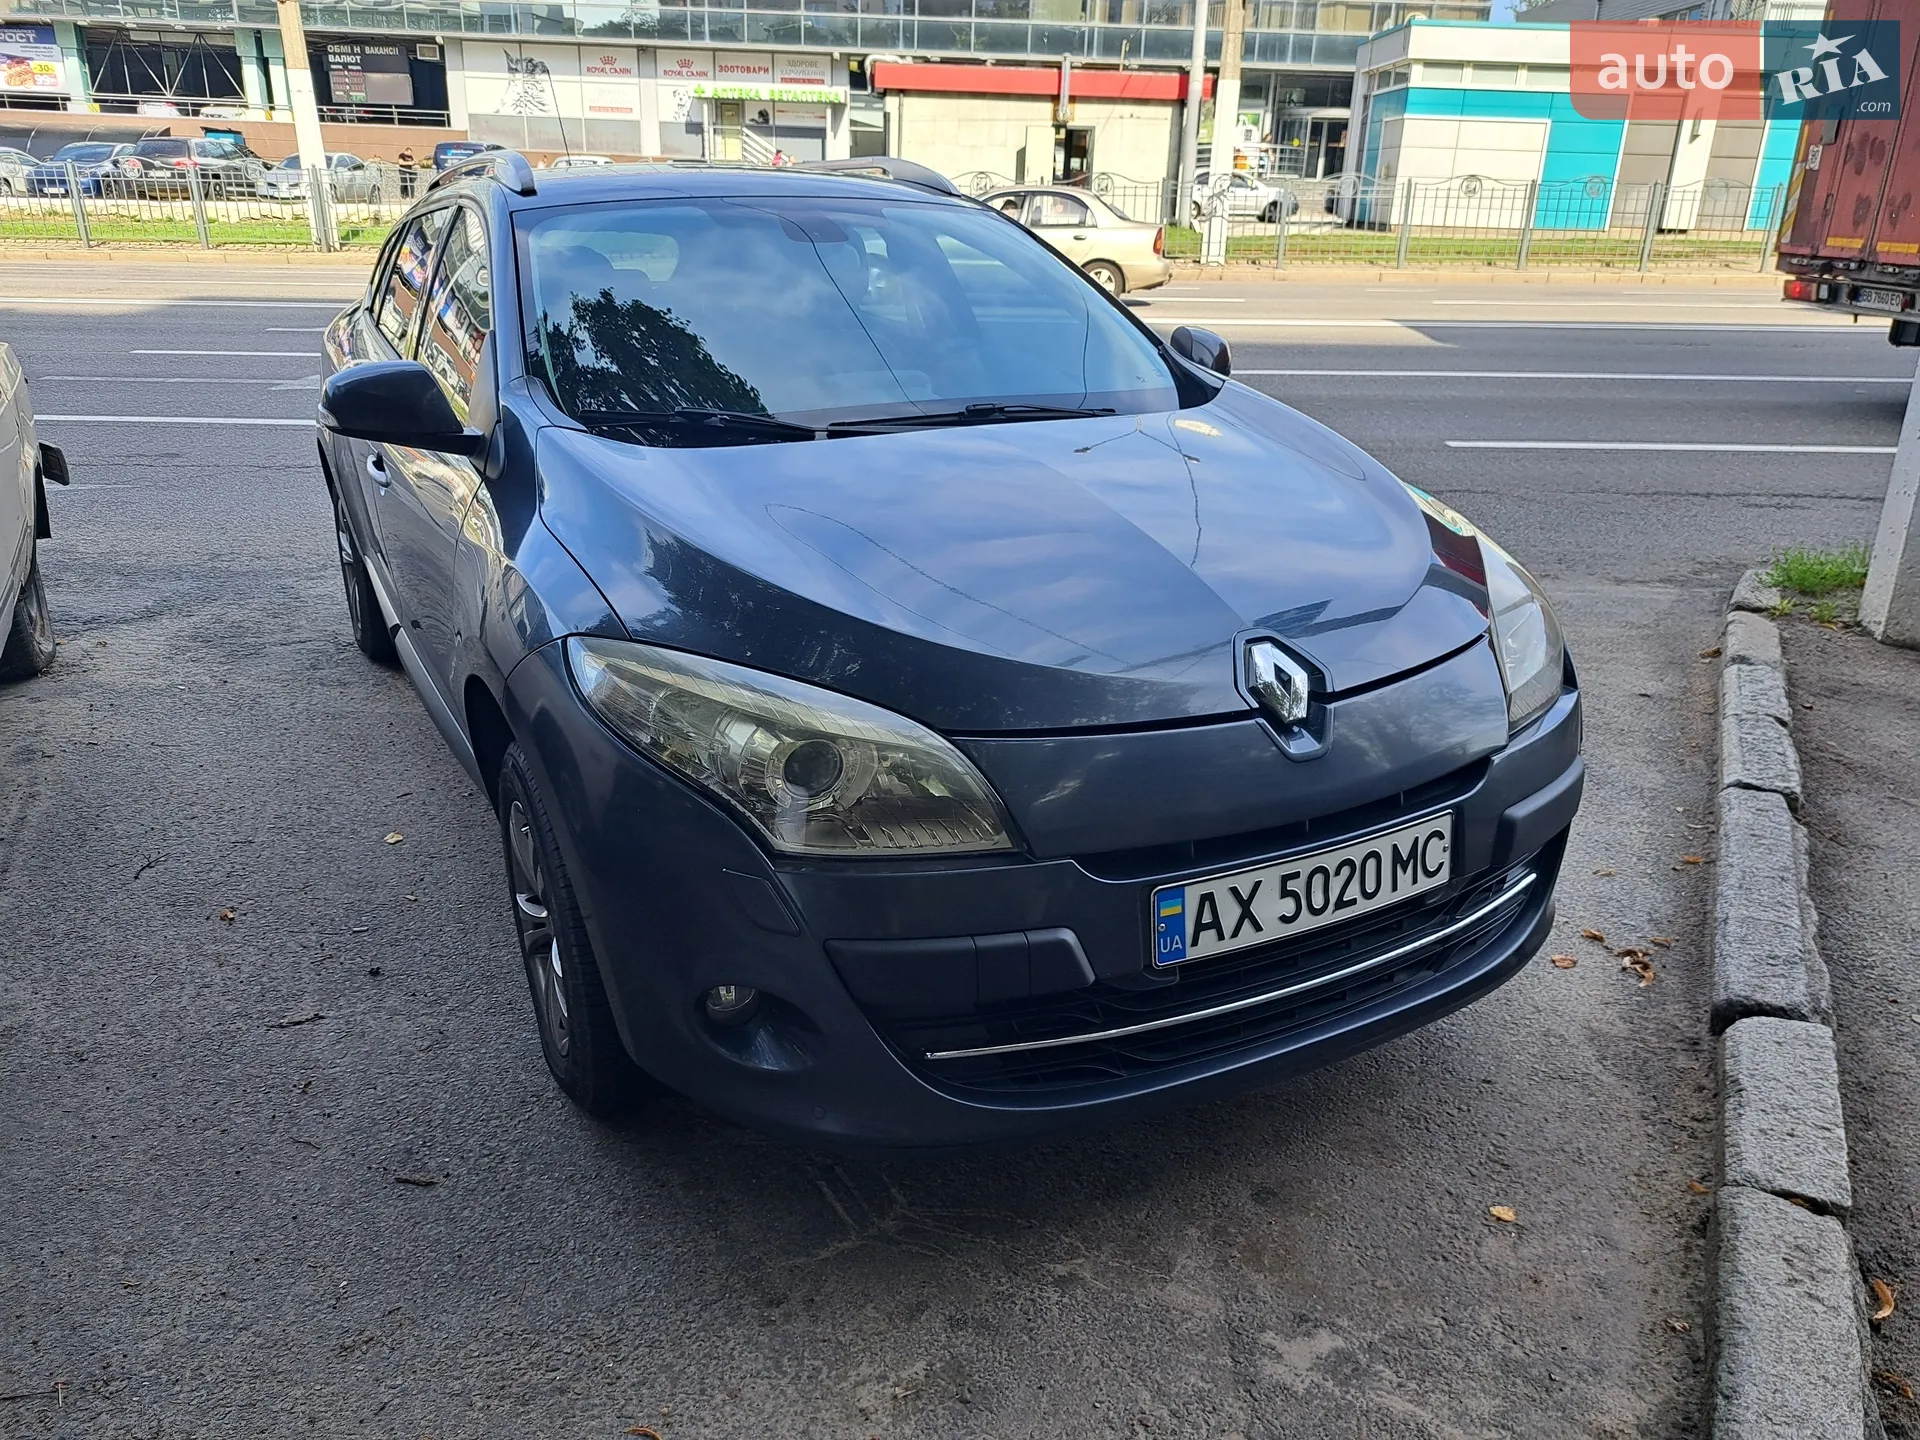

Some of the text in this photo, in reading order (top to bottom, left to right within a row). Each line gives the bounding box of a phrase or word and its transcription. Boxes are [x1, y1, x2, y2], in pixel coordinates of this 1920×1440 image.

[328, 55, 361, 63] ВАЛЮТ
[786, 60, 819, 68] ЗДОРОВЕ
[586, 66, 632, 75] ROYAL CANIN
[663, 69, 709, 78] ROYAL CANIN
[717, 64, 770, 75] ЗООТОВАРИ
[712, 87, 842, 103] АПТЕКА ВЕТАПТЕКА
[1190, 828, 1446, 948] AX 5020 MC
[1160, 934, 1183, 953] UA
